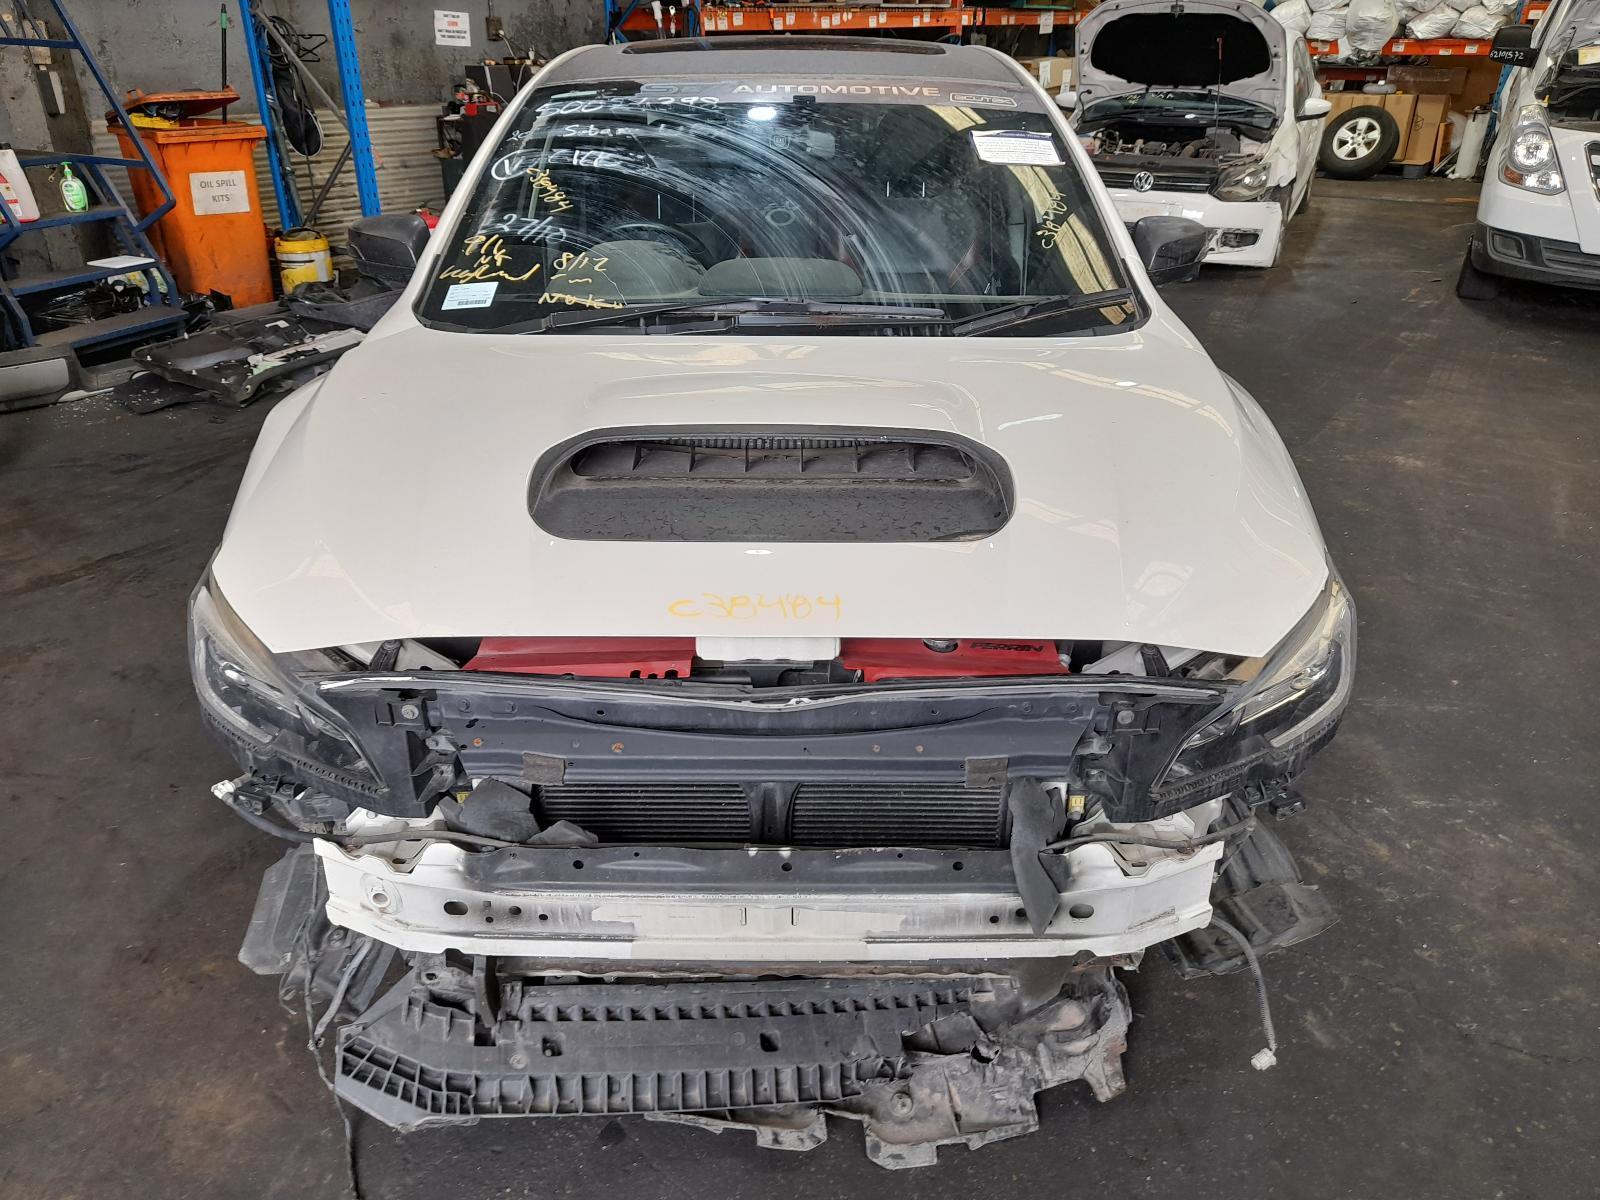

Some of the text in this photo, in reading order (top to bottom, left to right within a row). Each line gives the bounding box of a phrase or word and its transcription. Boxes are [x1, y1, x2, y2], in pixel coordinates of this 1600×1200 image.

[732, 84, 940, 97] AUTOMOTIVE
[216, 179, 237, 187] SPILL
[211, 194, 231, 202] KITS
